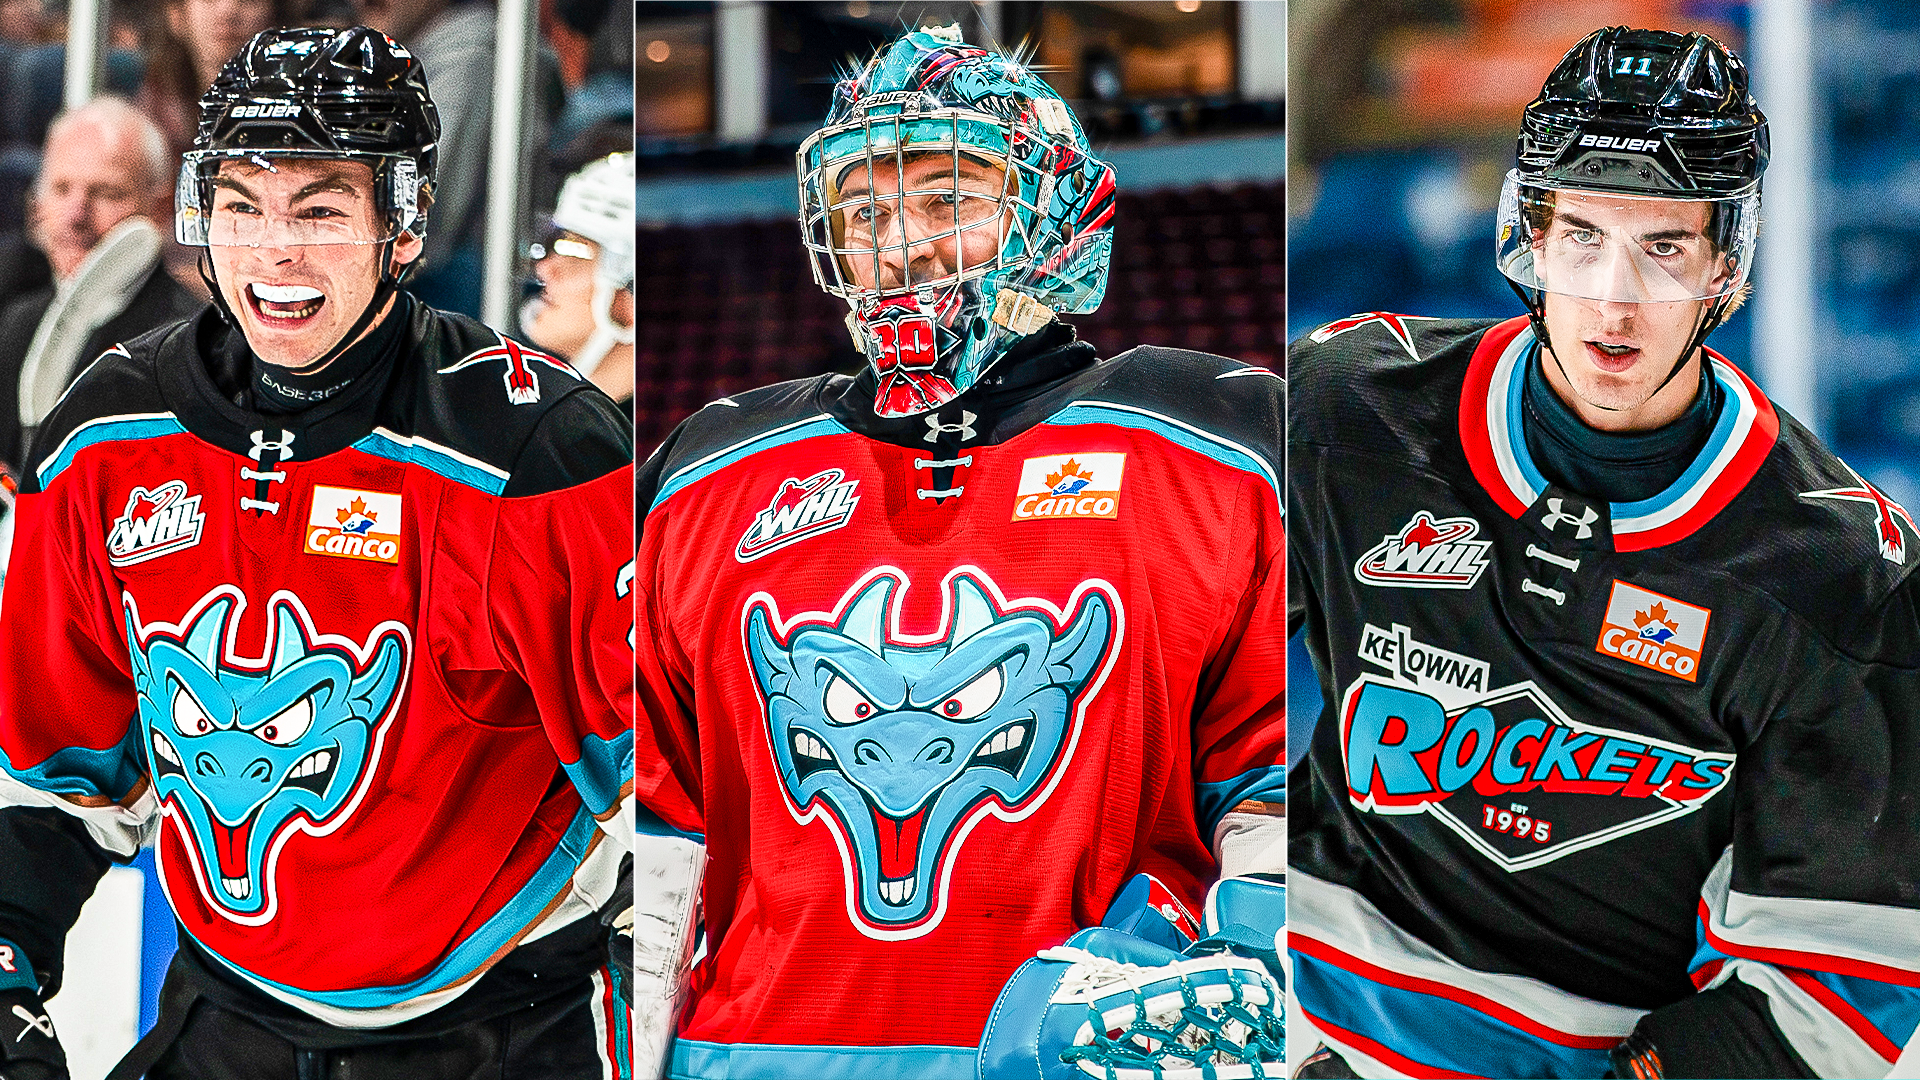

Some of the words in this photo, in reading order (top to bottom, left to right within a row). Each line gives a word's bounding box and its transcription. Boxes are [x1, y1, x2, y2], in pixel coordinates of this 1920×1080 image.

[1615, 56, 1652, 77] 11
[230, 105, 302, 118] BAUER
[1578, 134, 1661, 153] BAUER
[868, 315, 938, 377] 30
[117, 495, 200, 552] WHL
[757, 482, 856, 543] WHL
[1015, 495, 1115, 518] Canco
[308, 527, 397, 560] Canco
[1382, 540, 1483, 575] WHL
[1363, 630, 1484, 694] KELOWNA
[1602, 628, 1695, 675] Canco
[1345, 681, 1735, 800] ROCKETS
[1483, 804, 1551, 843] 1995
[1510, 802, 1529, 815] EST
